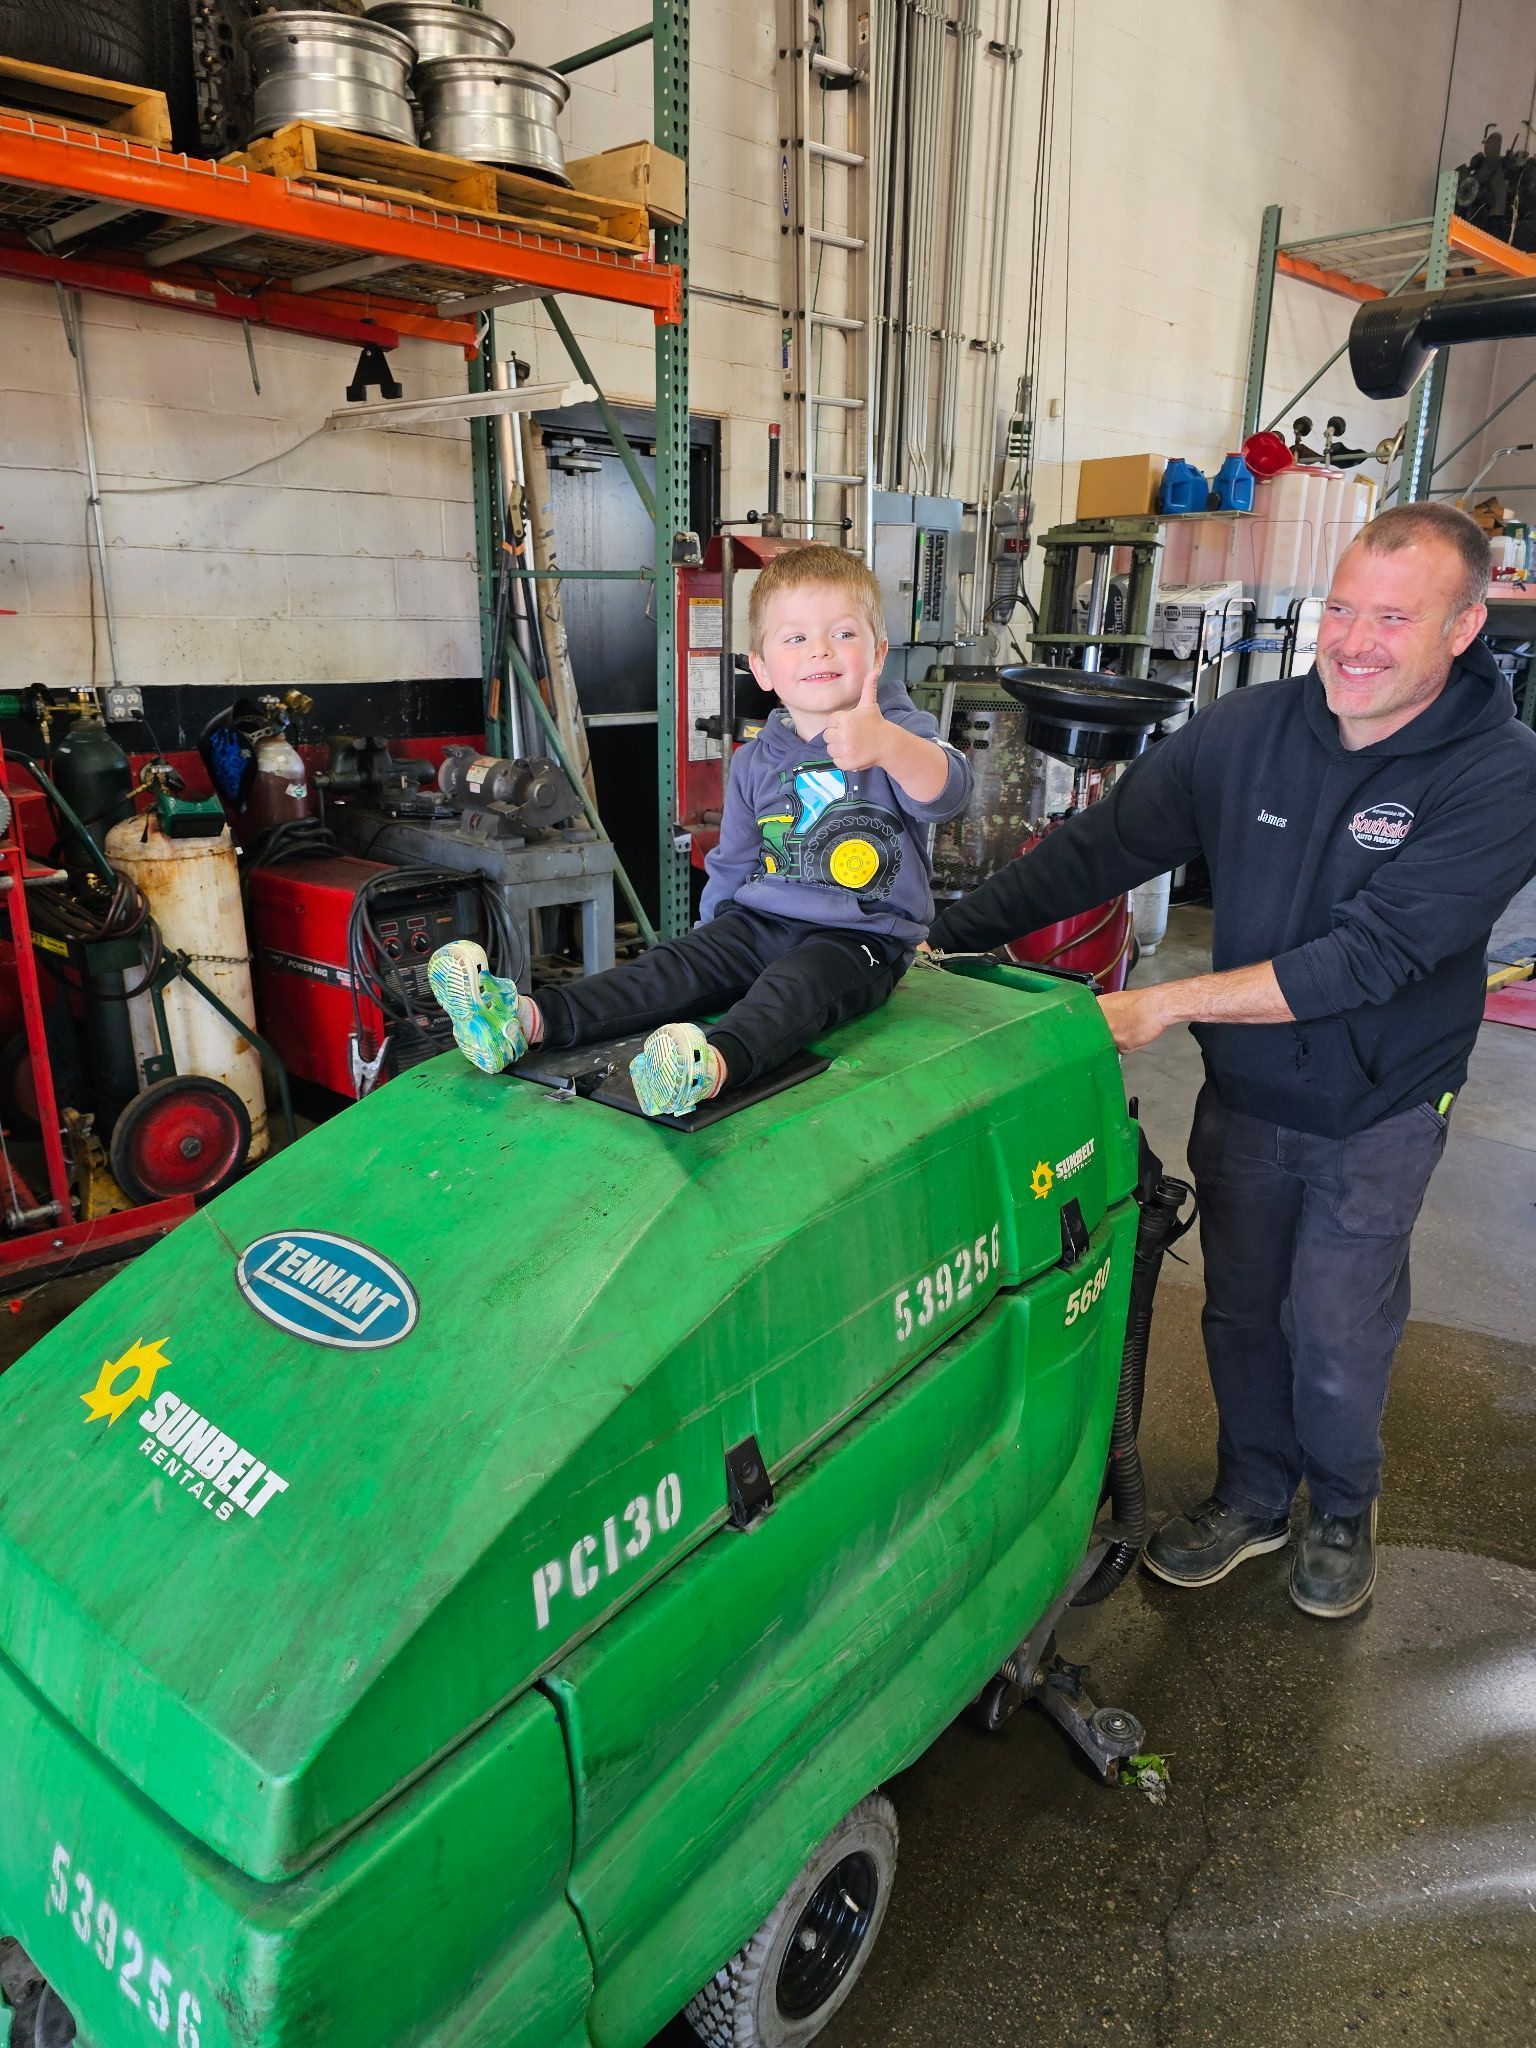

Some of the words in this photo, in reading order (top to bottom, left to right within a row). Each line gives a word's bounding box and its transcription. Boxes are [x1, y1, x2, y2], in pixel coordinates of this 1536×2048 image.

[1113, 596, 1123, 635] NTHETIC
[1257, 809, 1288, 828] James
[1348, 812, 1413, 839] Southsid
[1356, 832, 1373, 842] AUTO
[1373, 835, 1401, 846] REPAIR
[287, 959, 313, 973] POWER
[313, 967, 328, 977] MIG
[1055, 1137, 1095, 1179] SUNBELT
[252, 1240, 401, 1335] TENNANT
[895, 1223, 999, 1341] 539256
[1065, 1257, 1111, 1326] 5680
[138, 1390, 290, 1518] SUNBELT
[138, 1437, 235, 1521] RENTALS
[50, 1841, 202, 2048] 539256
